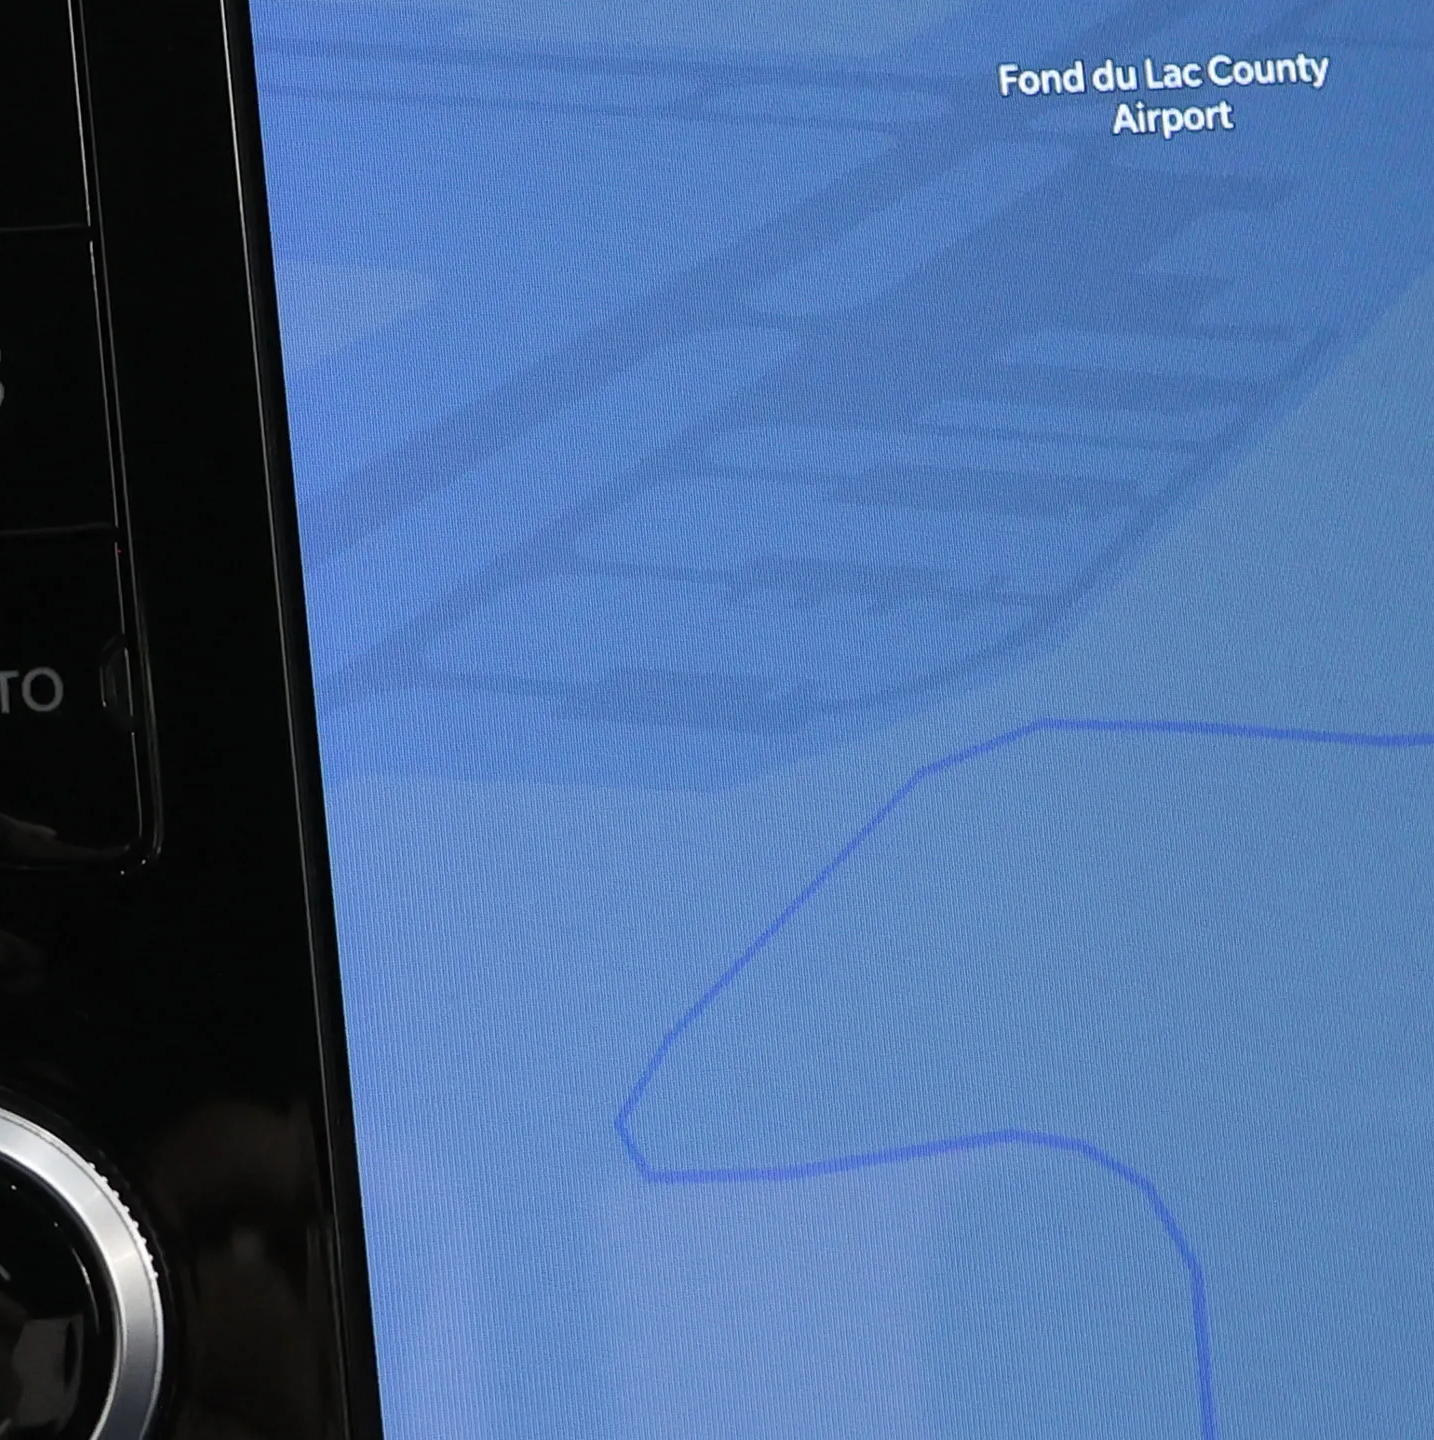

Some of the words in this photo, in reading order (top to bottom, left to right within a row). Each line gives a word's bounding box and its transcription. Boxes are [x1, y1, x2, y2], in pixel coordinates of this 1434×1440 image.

[998, 59, 1086, 97] Fond
[1091, 58, 1138, 93] du
[1143, 57, 1204, 90] Lac
[1206, 52, 1330, 89] County
[1112, 100, 1235, 140] Airport
